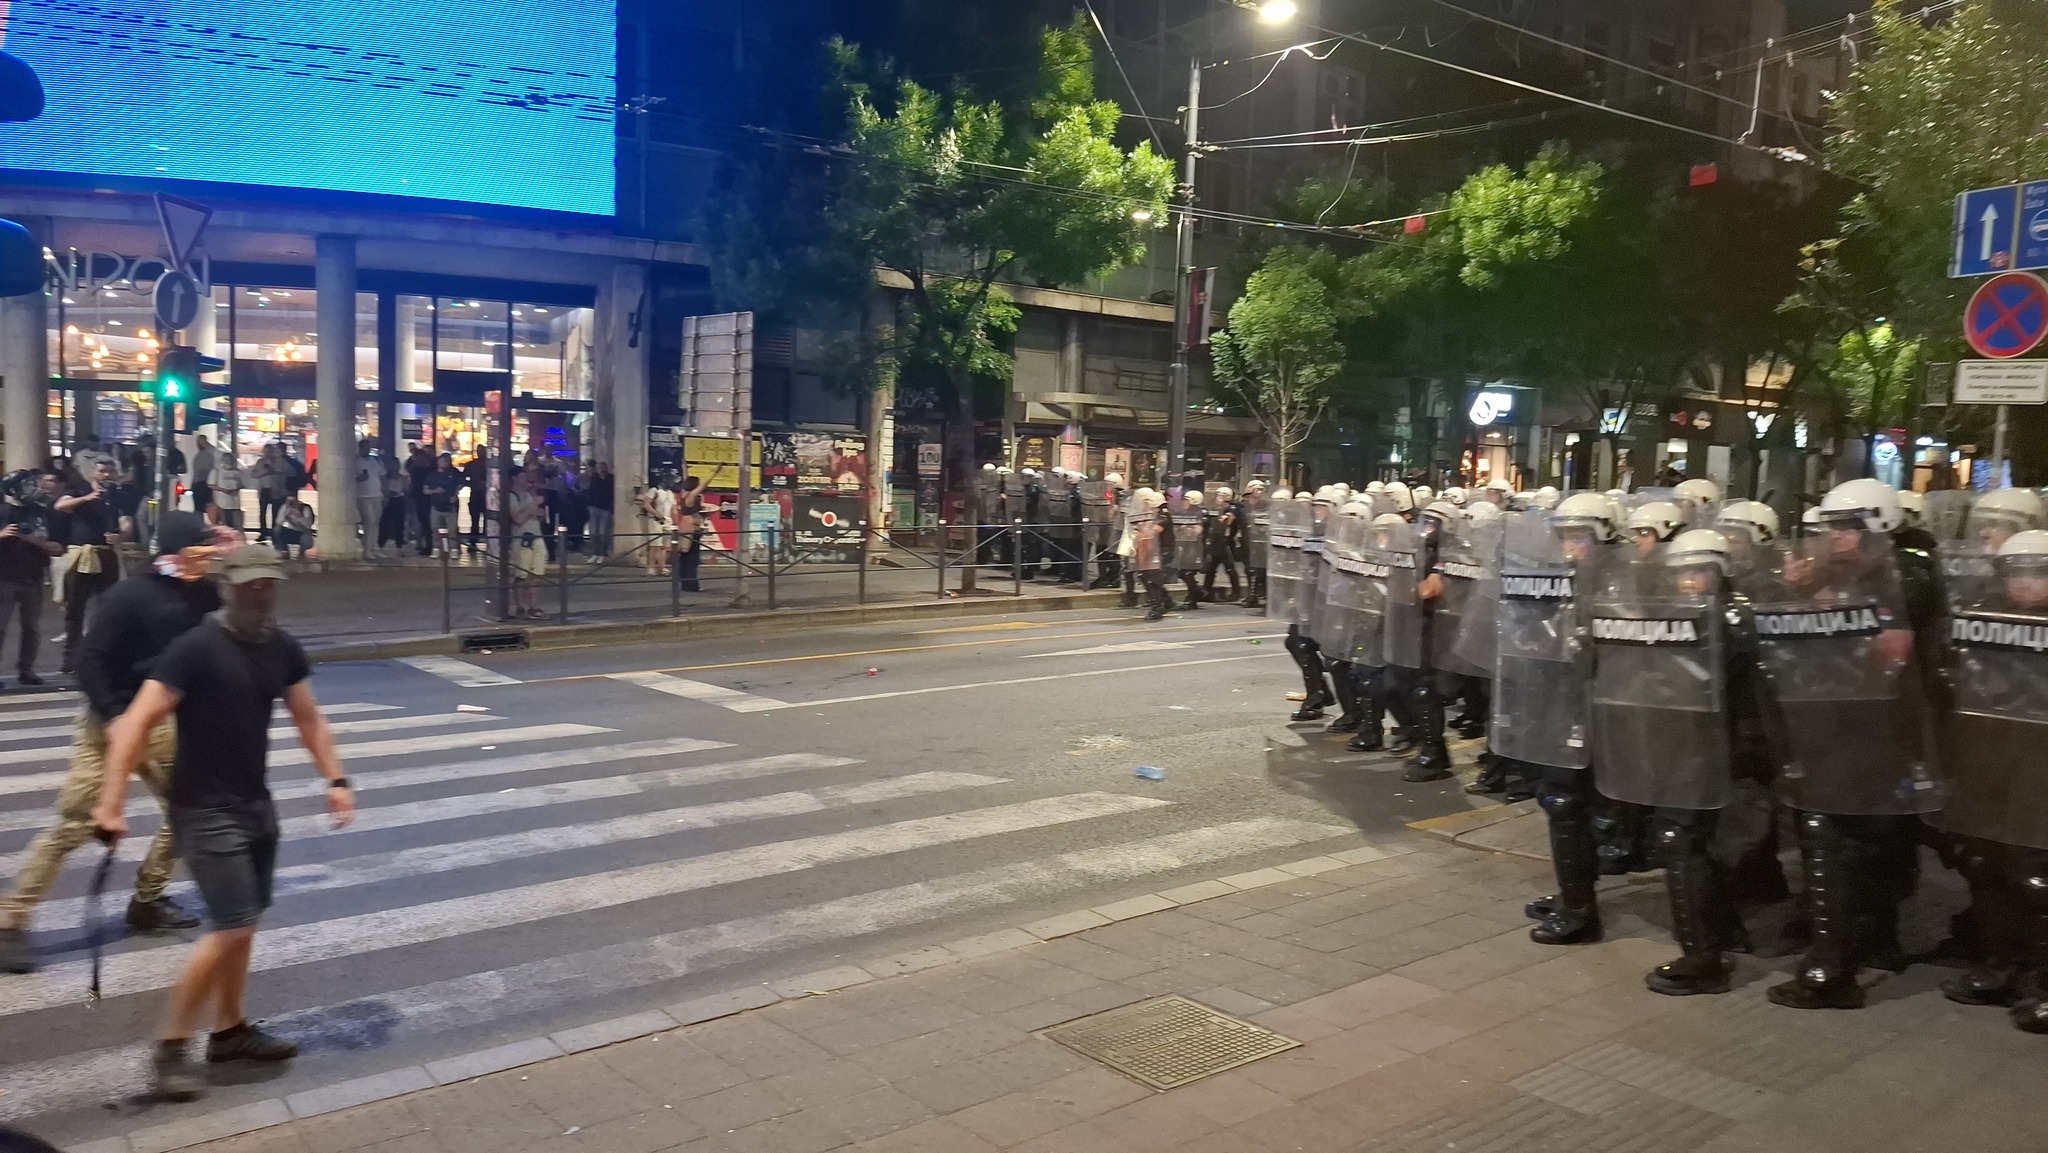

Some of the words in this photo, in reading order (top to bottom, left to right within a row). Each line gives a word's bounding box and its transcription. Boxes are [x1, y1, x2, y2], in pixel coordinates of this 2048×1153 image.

[1501, 577, 1573, 599] ОЛИЦИЈА
[1592, 618, 1698, 644] ПОЛИЦИЈА
[1755, 608, 1879, 637] ПОЛИЦИЈА
